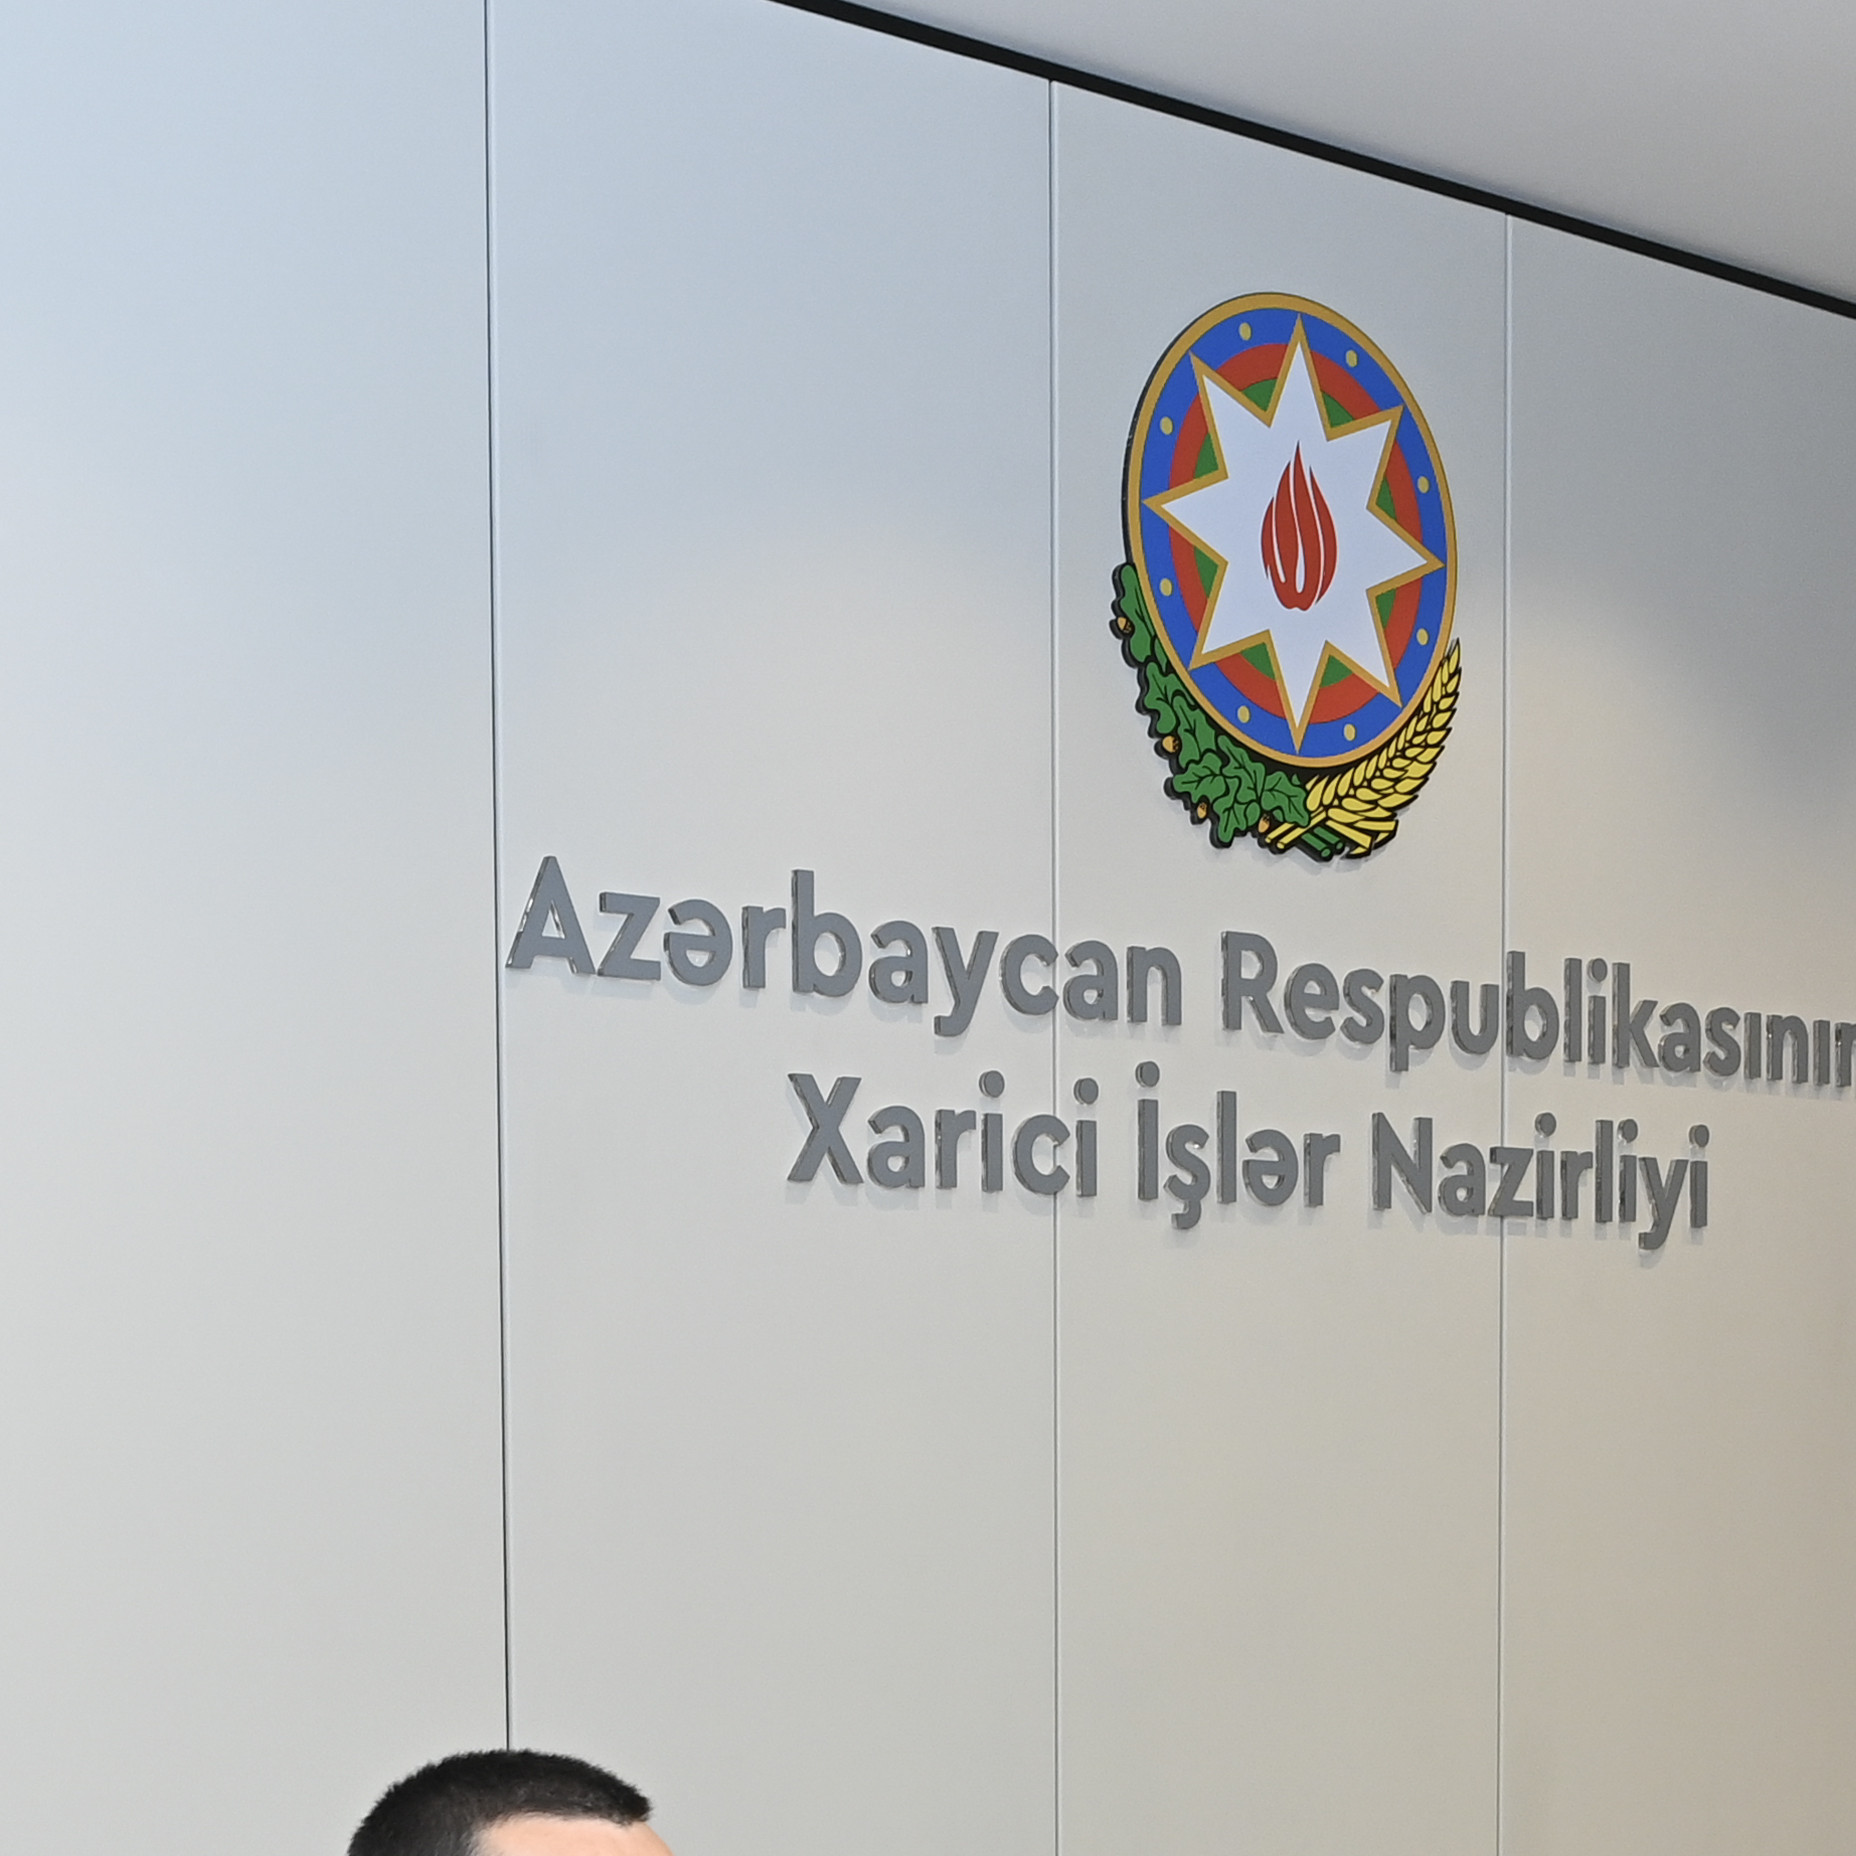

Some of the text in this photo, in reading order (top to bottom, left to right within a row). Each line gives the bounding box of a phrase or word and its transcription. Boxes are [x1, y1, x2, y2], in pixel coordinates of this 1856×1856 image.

[505, 855, 1183, 1039] Azərbaycan
[787, 1060, 1712, 1252] Xarici İşlər Nazirliyi
